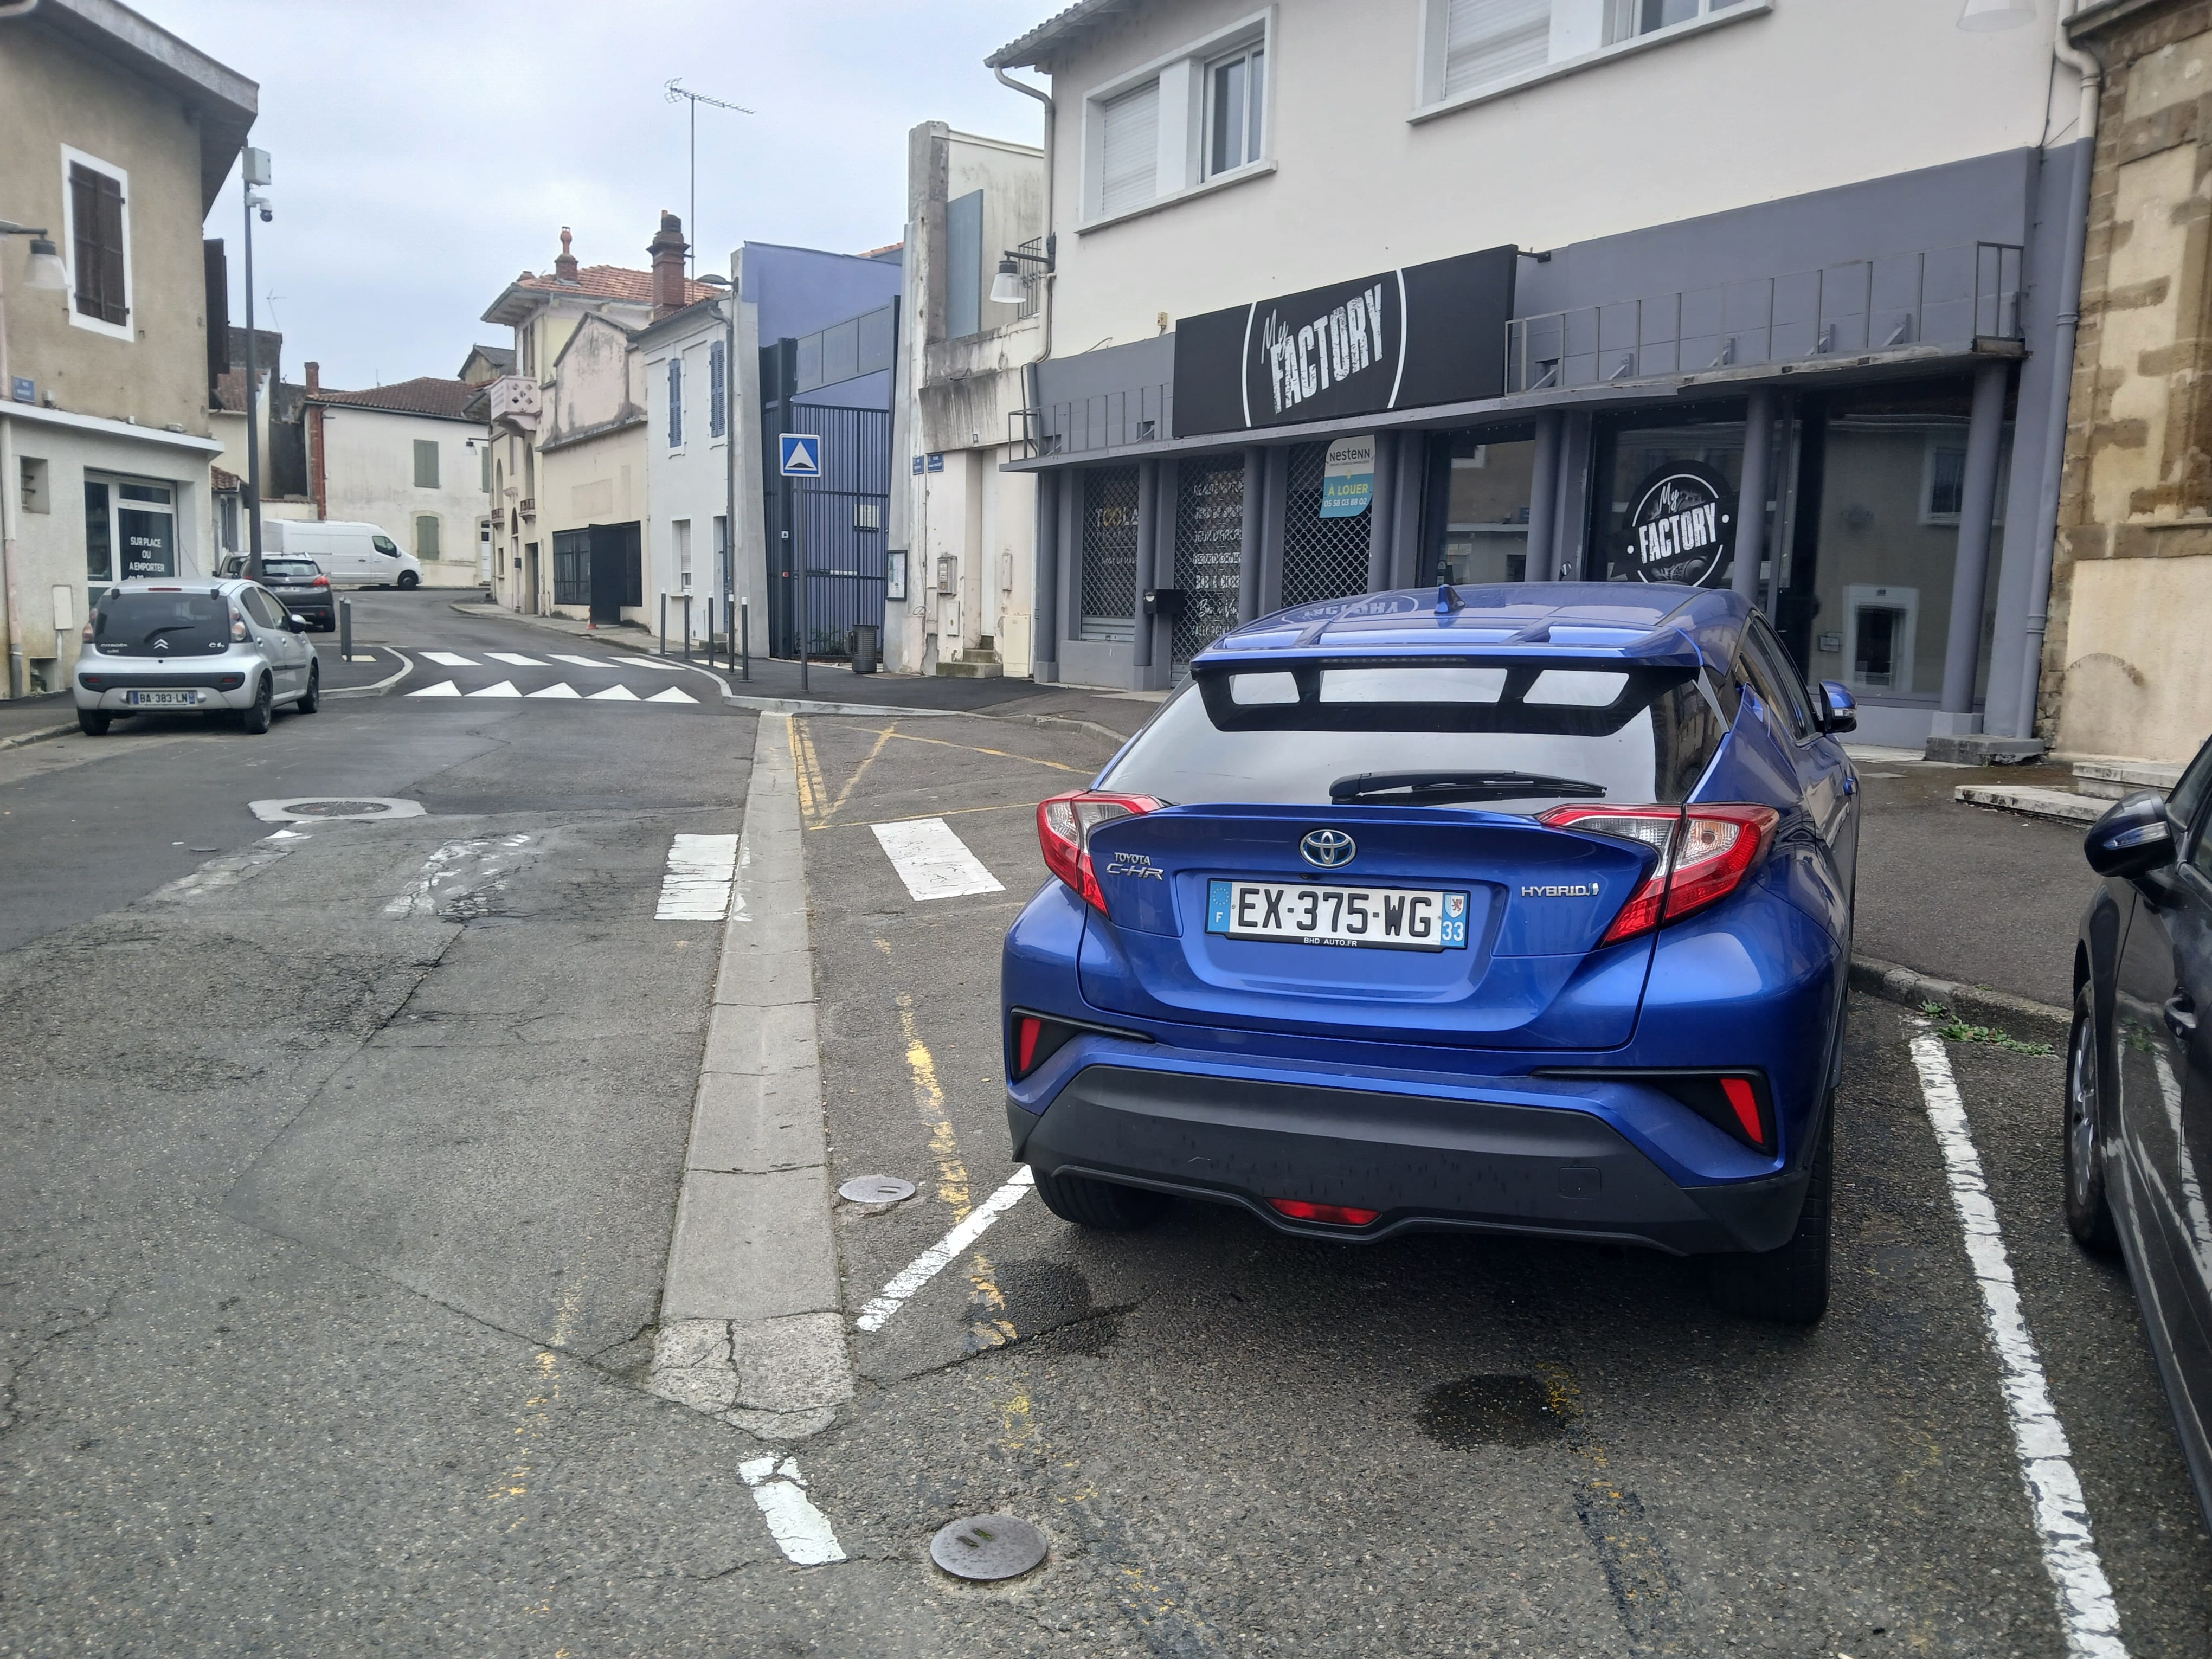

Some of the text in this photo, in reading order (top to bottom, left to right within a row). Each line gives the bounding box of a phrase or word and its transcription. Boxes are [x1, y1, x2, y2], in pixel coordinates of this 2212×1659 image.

[1261, 308, 1289, 364] My
[1270, 283, 1382, 415] FACTORY
[1328, 483, 1368, 496] À LOUER
[1659, 482, 1680, 513] My
[1639, 502, 1716, 564] FACTORY
[130, 536, 162, 548] SUR PLACE
[142, 550, 151, 559] OU
[134, 562, 165, 572] EMPORTER
[140, 693, 188, 703] BA-383-LN
[1114, 852, 1150, 866] TOYOTA
[1107, 863, 1163, 880] C-HR
[1521, 886, 1589, 897] HYBRID
[1216, 912, 1224, 923] F
[1238, 888, 1432, 938] EX-375-WG
[1442, 921, 1464, 942] 33
[1323, 938, 1358, 947] AUTO.FR
